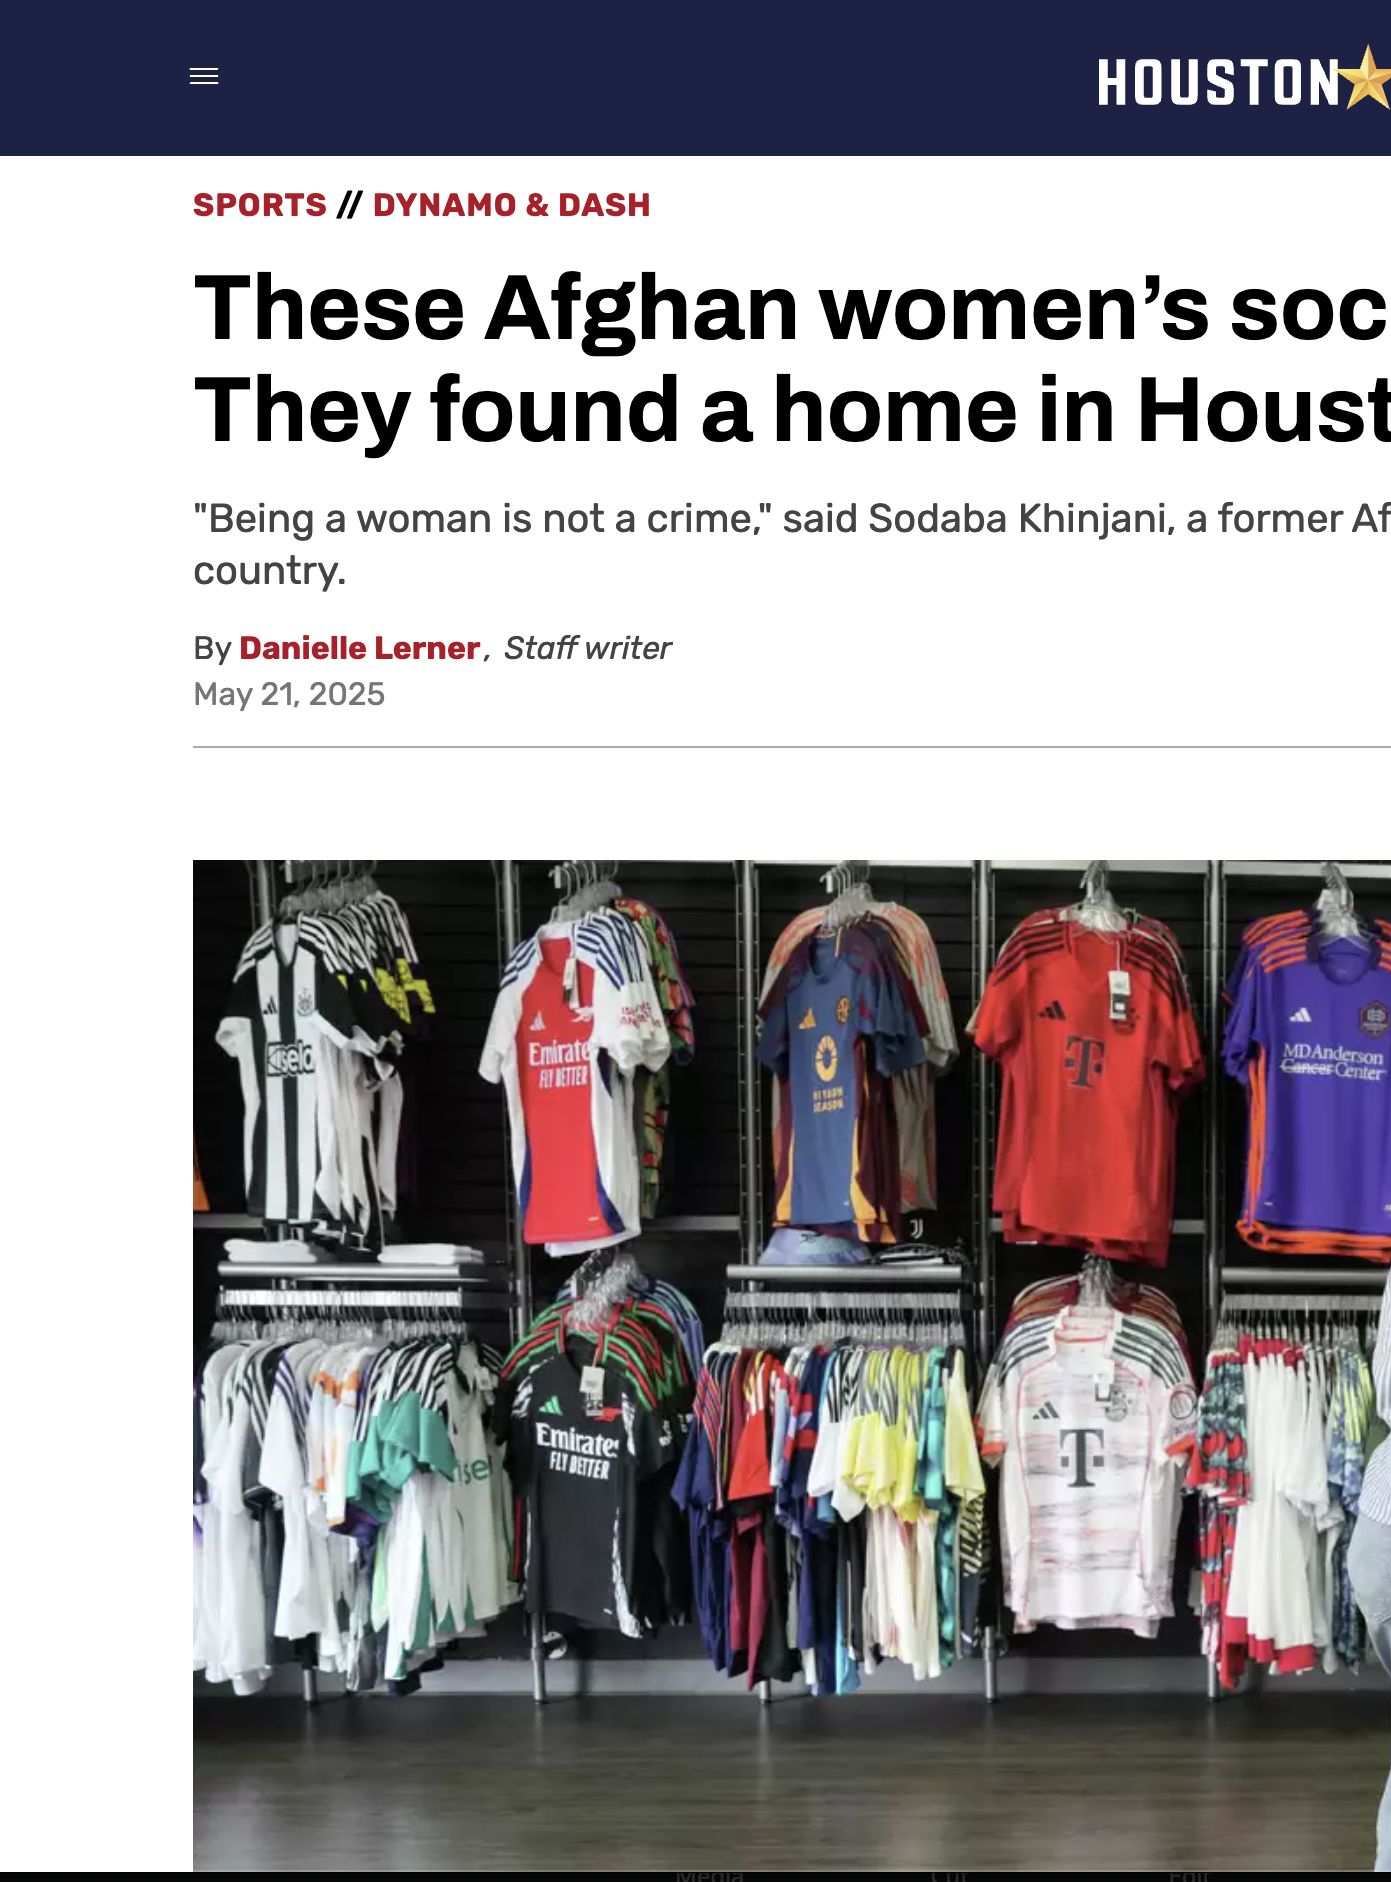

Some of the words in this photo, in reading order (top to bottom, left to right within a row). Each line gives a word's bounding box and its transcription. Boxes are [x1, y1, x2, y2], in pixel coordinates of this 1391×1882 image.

[1099, 59, 1339, 105] HOUSTON
[194, 193, 327, 218] SPORTS
[375, 193, 515, 218] DYNAMO
[526, 193, 549, 218] &
[560, 193, 650, 218] DASH
[195, 271, 463, 340] These
[484, 271, 795, 357] Afghan
[818, 275, 1208, 340] women’s
[195, 374, 412, 459] They
[430, 373, 677, 442] found
[702, 391, 754, 442] a
[777, 373, 1016, 442] home
[1042, 374, 1112, 441] in
[195, 503, 313, 541] "Being
[326, 510, 345, 533] a
[357, 510, 490, 533] woman
[504, 503, 531, 533] is
[545, 503, 605, 533] not
[616, 510, 635, 533] a
[648, 503, 771, 537] crime,"
[784, 503, 856, 533] said
[870, 503, 1006, 533] Sodaba
[1021, 503, 1174, 540] Khinjani,
[1187, 510, 1206, 533] a
[1218, 503, 1344, 533] former
[195, 555, 345, 592] country.
[195, 636, 232, 665] By
[241, 635, 366, 660] Danielle
[504, 635, 581, 660] Staff
[586, 635, 673, 660] writer
[195, 682, 253, 711] May
[262, 682, 299, 709] 21,
[310, 682, 384, 706] 2025
[529, 1040, 591, 1066] Emirate
[1283, 1043, 1312, 1059] MD
[1311, 1044, 1384, 1065] Anderson
[539, 1068, 555, 1089] FLY
[555, 1066, 588, 1088] BETTER
[1335, 1062, 1385, 1081] Center
[549, 1452, 570, 1472] FLY
[569, 1455, 611, 1480] BETTER
